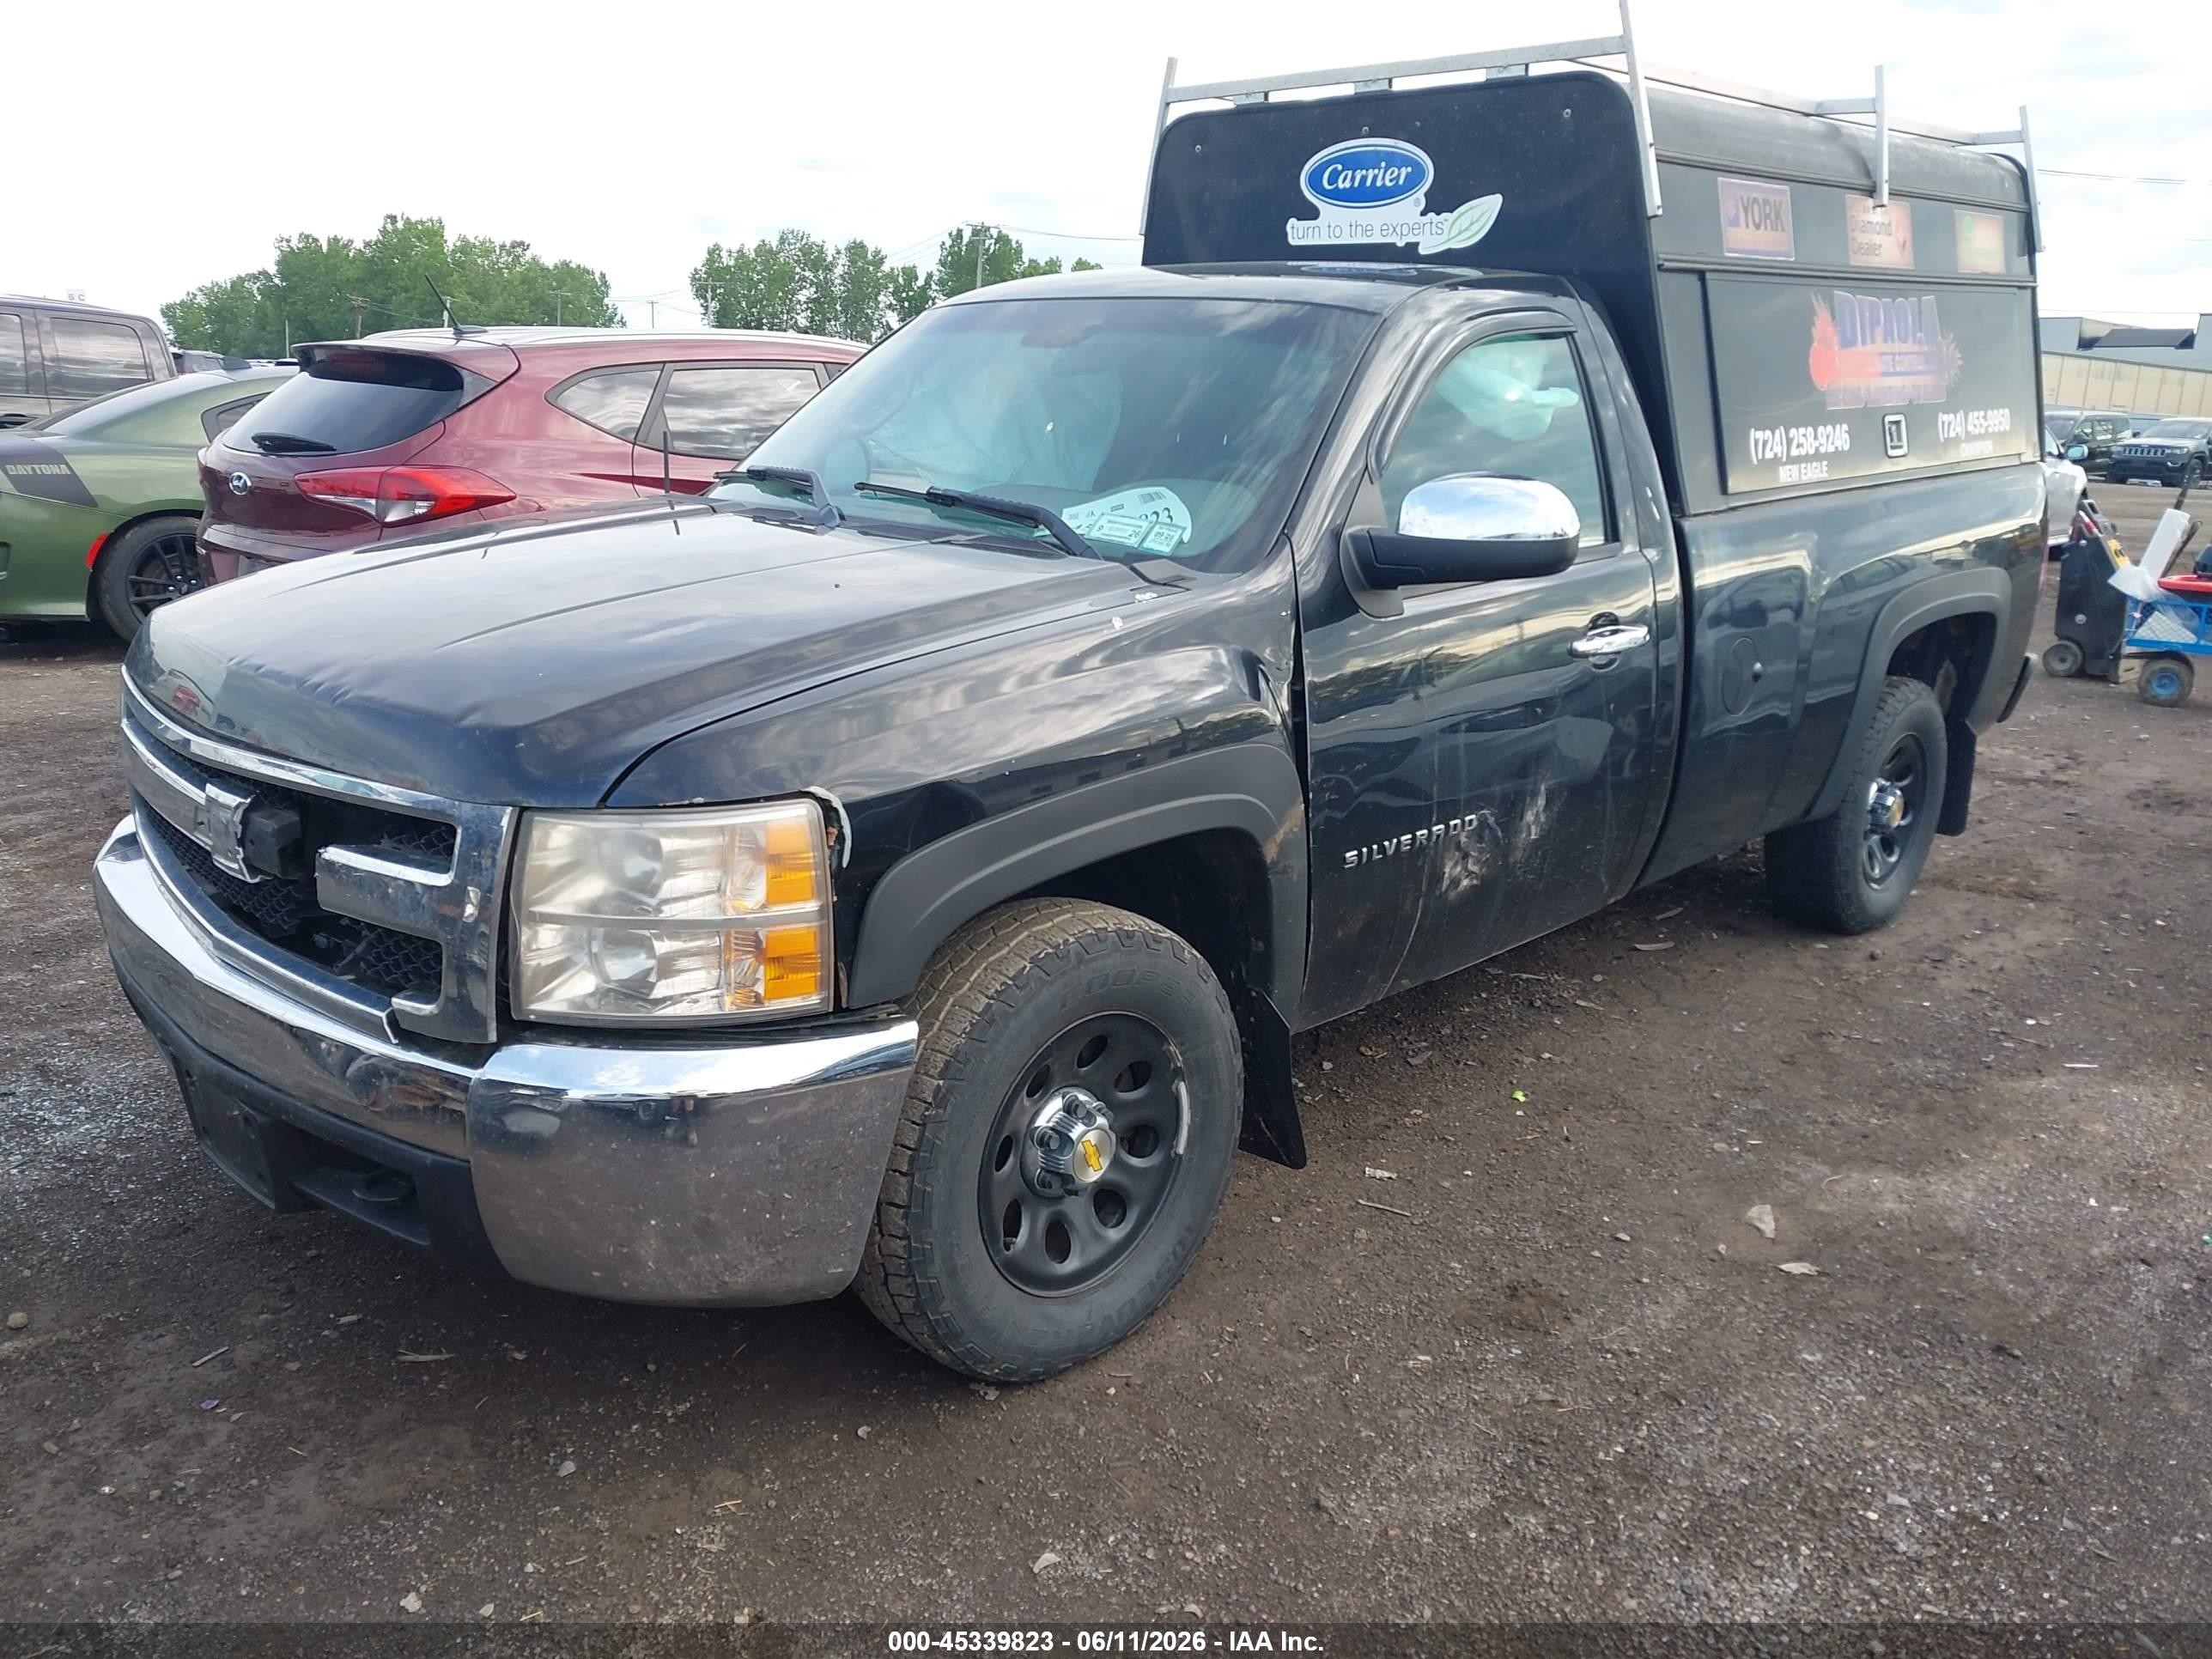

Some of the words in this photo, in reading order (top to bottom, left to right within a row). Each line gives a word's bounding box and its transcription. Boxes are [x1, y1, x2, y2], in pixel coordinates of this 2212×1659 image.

[1322, 161, 1413, 191] Carrier
[1740, 195, 1787, 232] YORK
[1850, 213, 1893, 236] Diamond
[1291, 223, 1322, 240] turn
[1327, 222, 1343, 239] to
[1349, 220, 1375, 238] the
[1850, 235, 1884, 258] Dealer
[1938, 410, 1966, 443] (724)
[1749, 425, 1787, 465] (724)
[1789, 422, 1850, 457] 258-9246
[5, 464, 71, 475] DAYTONA
[1778, 465, 1800, 483] NEW
[1800, 460, 1829, 480] EAGLE
[1343, 814, 1479, 869] SILVERADO
